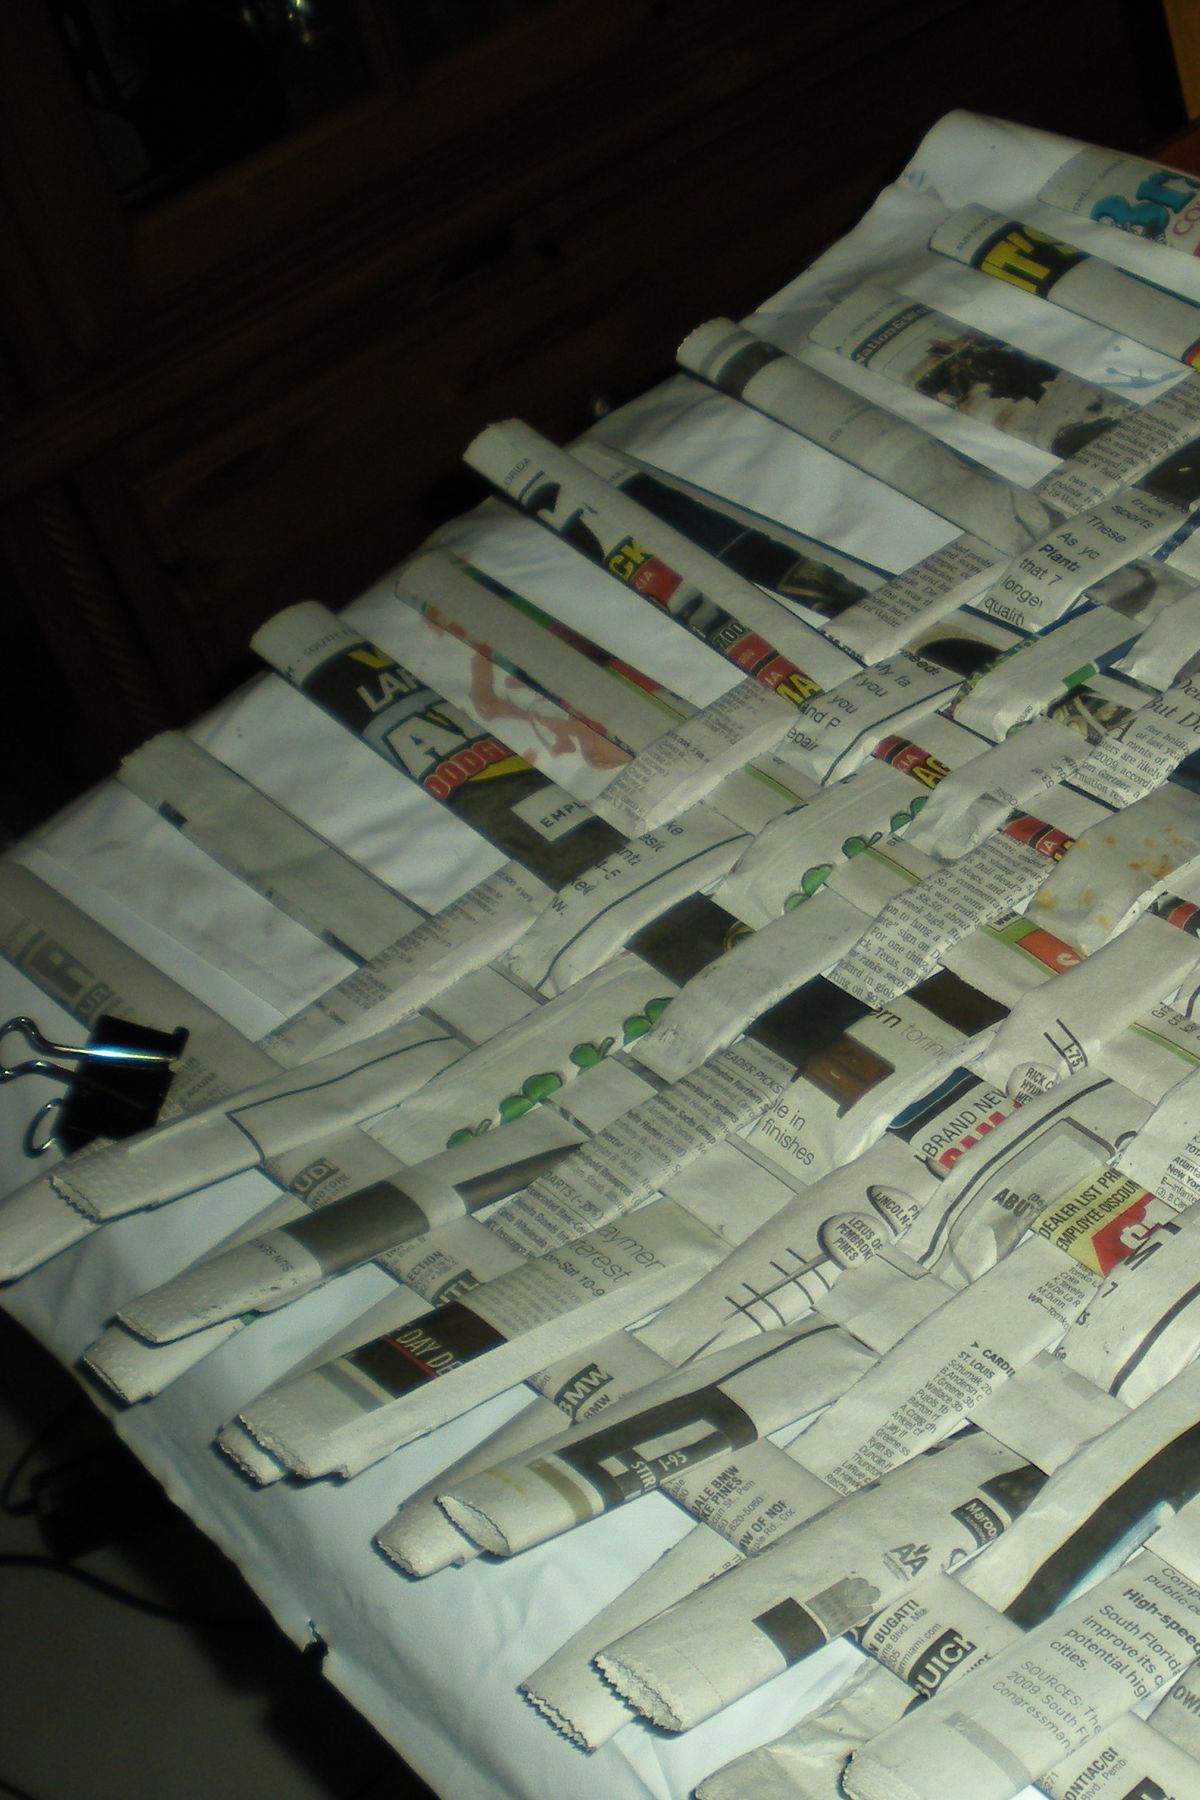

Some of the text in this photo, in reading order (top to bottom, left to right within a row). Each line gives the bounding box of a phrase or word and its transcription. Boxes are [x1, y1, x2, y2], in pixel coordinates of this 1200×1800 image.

[1087, 514, 1128, 544] These
[1111, 503, 1155, 530] sports
[1057, 532, 1078, 547] As
[1019, 557, 1049, 582] that
[860, 676, 889, 699] you
[830, 692, 859, 715] you
[1121, 753, 1137, 764] are
[792, 1109, 808, 1130] in
[759, 1118, 816, 1166] finishes
[919, 1113, 978, 1161] BRAND
[1167, 1163, 1187, 1180] New
[1036, 1184, 1104, 1239] DEALER LIST
[847, 1214, 877, 1242] LEXUS
[1055, 1210, 1105, 1253] EMPLOYEE
[831, 1236, 859, 1261] PINES
[577, 1274, 606, 1297] 10-9
[399, 1327, 435, 1358] DAY
[957, 1351, 995, 1380] ST. LOUIS
[710, 1464, 742, 1494] BMW
[712, 1478, 743, 1506] PINES
[751, 1517, 770, 1536] OF
[873, 1600, 920, 1644] BUGATTI
[1098, 1602, 1146, 1643] South
[1049, 1638, 1089, 1672] cities.
[1063, 1627, 1127, 1678] potential
[1080, 1614, 1160, 1676] improve its
[1020, 1659, 1086, 1710] SOURCES:
[990, 1680, 1072, 1751] Congressman
[1040, 1694, 1078, 1731] South
